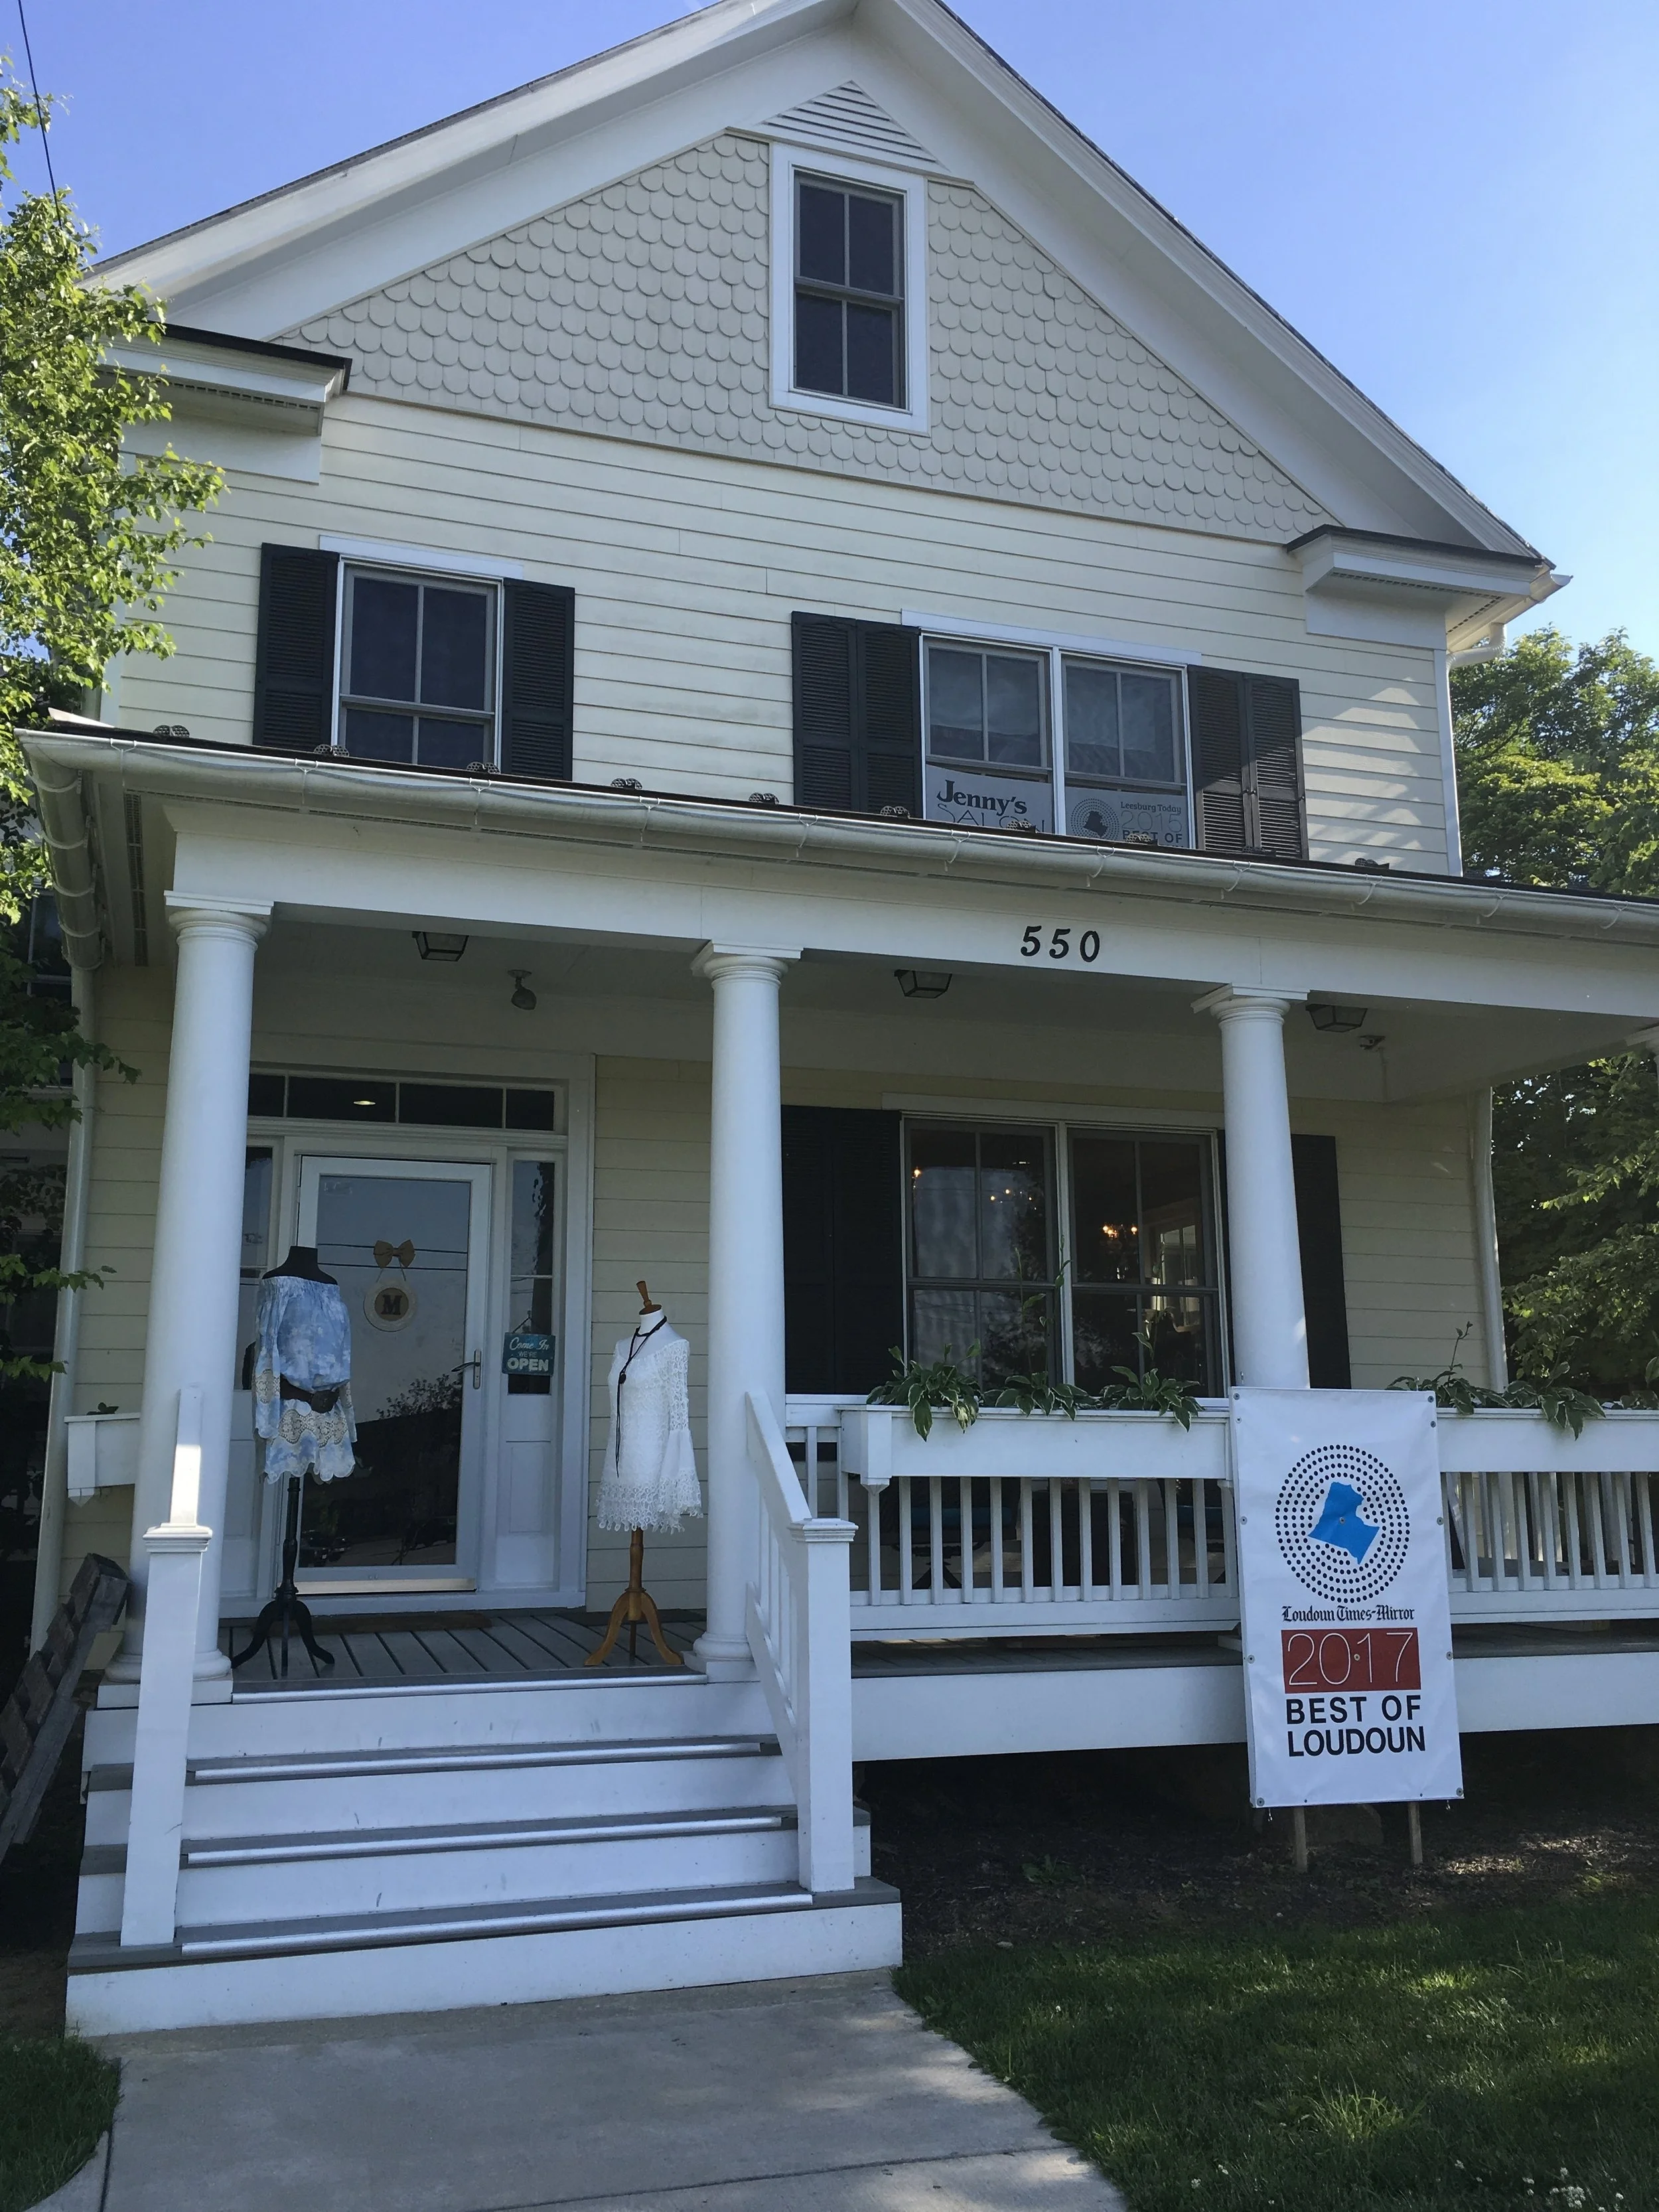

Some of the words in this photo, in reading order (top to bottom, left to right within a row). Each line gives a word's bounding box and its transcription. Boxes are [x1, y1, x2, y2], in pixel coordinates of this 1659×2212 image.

[936, 779, 1027, 816] Jenny's
[1120, 801, 1156, 813] Leesburg
[1157, 804, 1182, 814] Today
[1121, 810, 1182, 833] 2015
[1122, 830, 1158, 842] BT
[1165, 833, 1183, 844] OF
[1021, 925, 1100, 962] 550
[381, 1295, 402, 1315] M
[509, 1337, 534, 1351] Come
[536, 1339, 549, 1351] In
[507, 1357, 549, 1372] OPEN
[1281, 1605, 1335, 1622] Loudoun
[1336, 1604, 1415, 1621] Times-Mirror
[1287, 1632, 1413, 1685] 2017
[1286, 1696, 1367, 1724] BEST
[1382, 1695, 1421, 1721] OF
[1287, 1726, 1425, 1757] LOUDOUN
